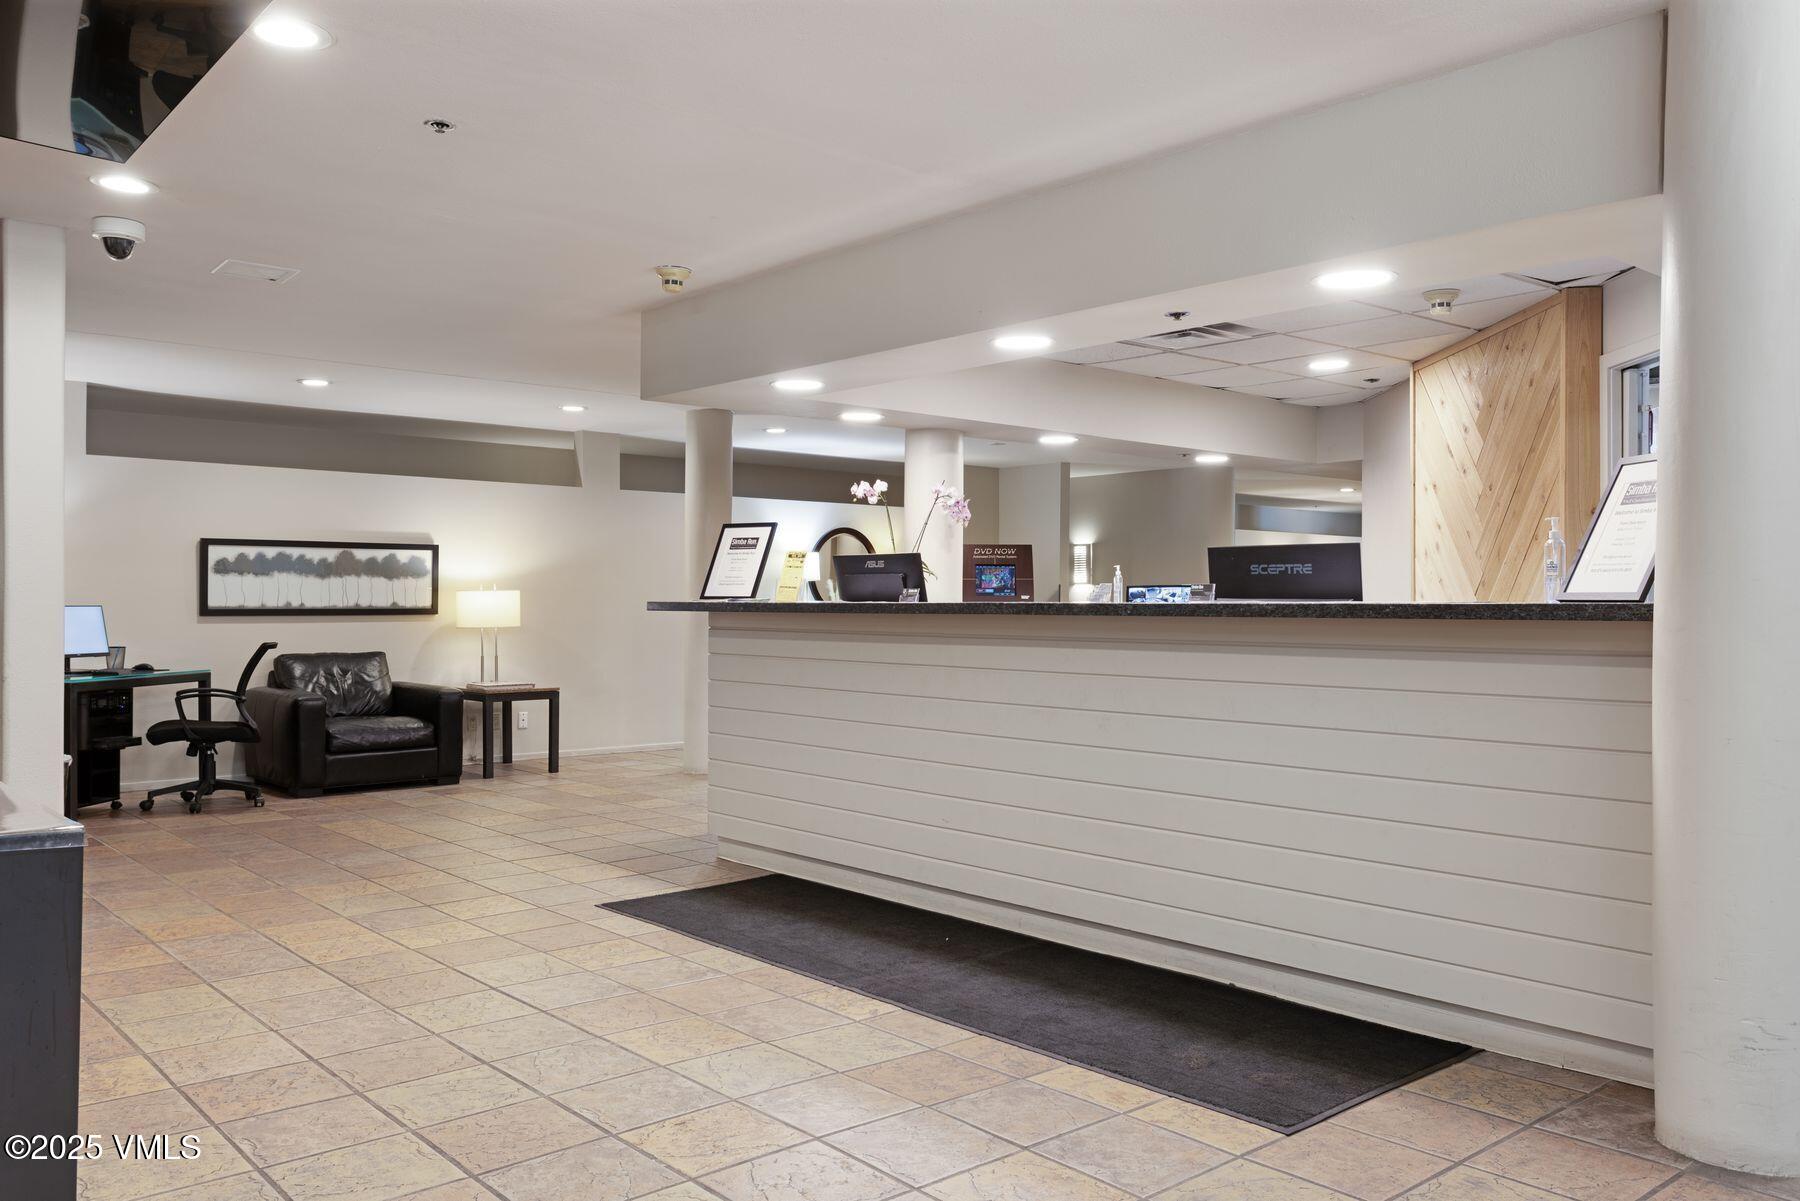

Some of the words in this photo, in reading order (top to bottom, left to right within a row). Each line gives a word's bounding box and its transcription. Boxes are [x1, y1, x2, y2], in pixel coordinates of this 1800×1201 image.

[1625, 483, 1650, 496] Simba
[994, 547, 1017, 555] NOW
[865, 560, 885, 568] ASUS
[1250, 563, 1313, 575] SCEPTRE
